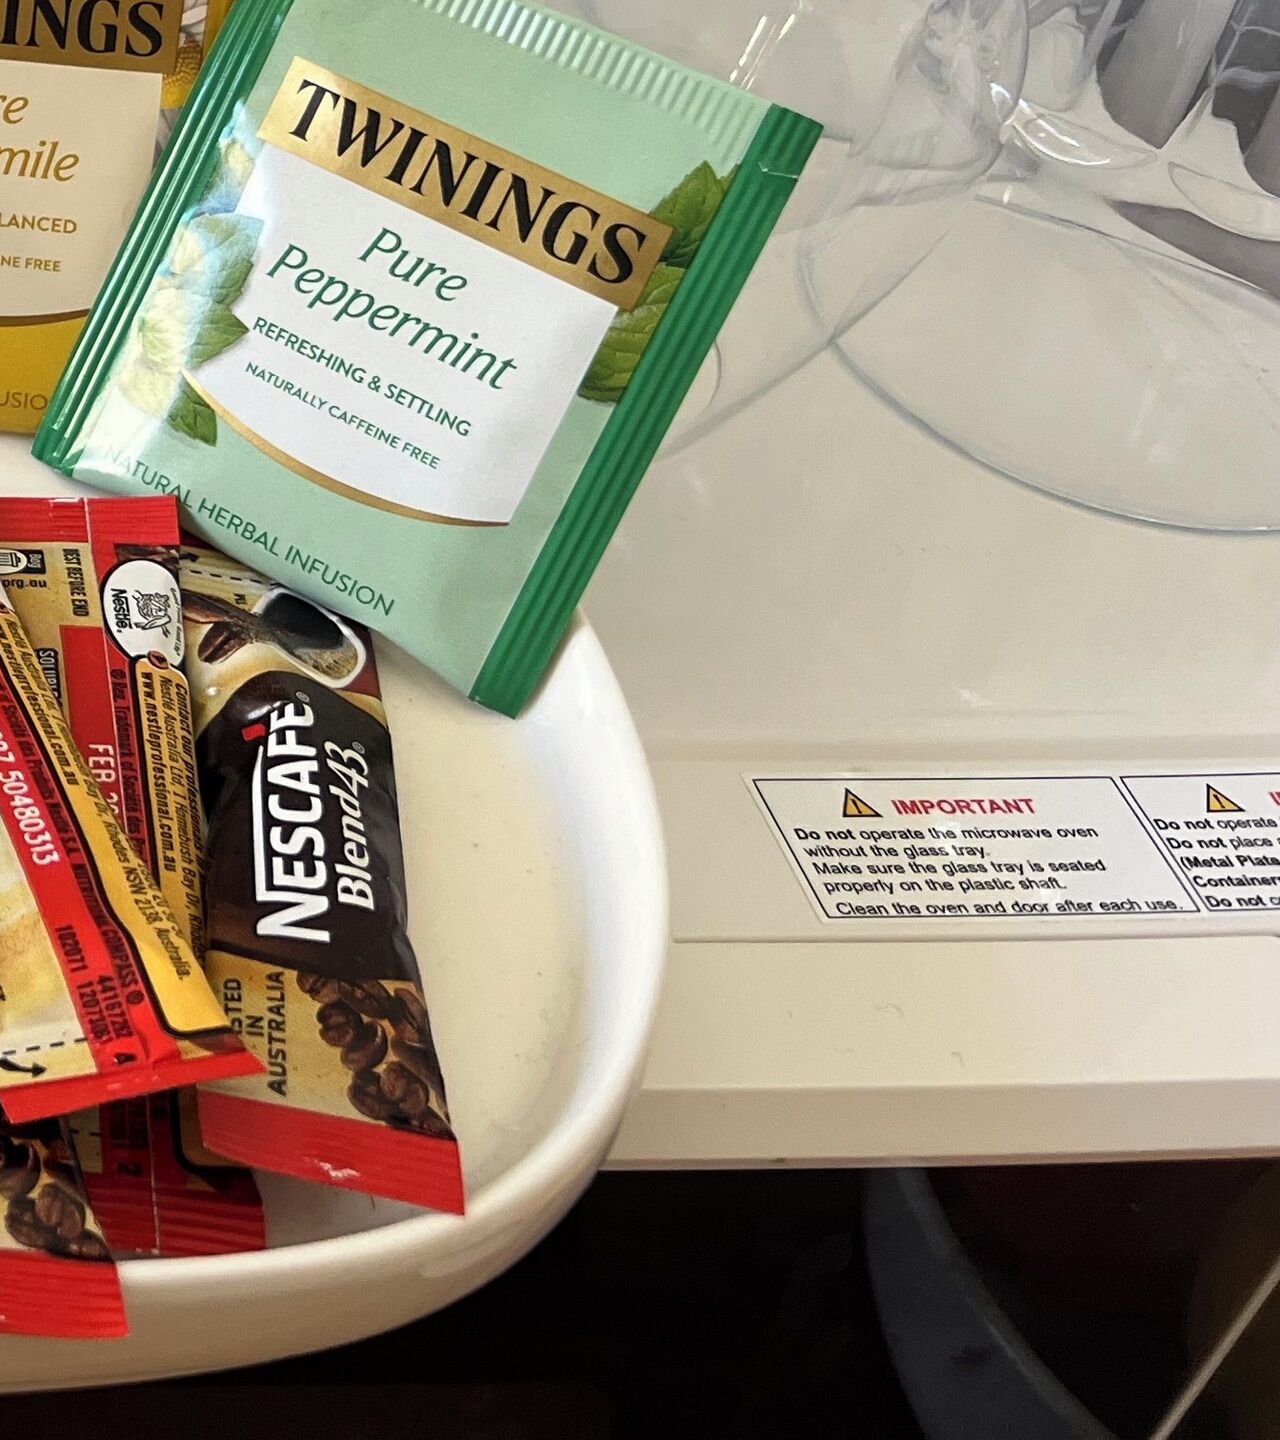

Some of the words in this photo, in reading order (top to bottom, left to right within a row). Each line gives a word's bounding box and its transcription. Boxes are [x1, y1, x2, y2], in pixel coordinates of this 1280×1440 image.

[288, 79, 649, 287] TWININGS
[25, 257, 61, 272] FREE
[356, 227, 468, 303] Pure
[266, 243, 517, 391] Peppermint
[253, 315, 365, 389] REFRESHING
[367, 374, 380, 392] &
[383, 381, 472, 438] SETTLING
[244, 361, 328, 411] NATURALLY
[328, 405, 400, 451] CAFFEINE
[402, 440, 441, 471] FREE
[104, 446, 193, 509] NATURAL
[198, 498, 279, 556] HERBAL
[285, 545, 395, 616] INFUSION
[891, 798, 1036, 815] IMPORTANT
[794, 828, 820, 840] Do
[826, 829, 855, 840] not
[860, 830, 924, 842] operate
[930, 827, 955, 840] the
[961, 827, 1052, 839] microwave
[1057, 828, 1098, 839] oven
[805, 845, 867, 857] without
[870, 845, 899, 857] the
[904, 845, 949, 859] glass
[952, 845, 990, 859] tray.
[812, 862, 862, 874] Make
[869, 864, 905, 874] sure
[909, 862, 937, 874] the
[942, 861, 988, 876] glass
[991, 861, 1023, 875] tray
[1031, 860, 1044, 872] is
[1048, 859, 1106, 872] seated
[823, 880, 894, 894] properly
[900, 881, 922, 891] on
[925, 879, 954, 891] the
[959, 878, 1015, 893] plastic
[1020, 878, 1066, 890] shaft.
[836, 902, 889, 915] Clean
[892, 902, 921, 914] the
[926, 904, 970, 914] oven
[975, 901, 1003, 913] and
[1011, 900, 1049, 913] door
[1056, 900, 1092, 912] after
[1099, 899, 1139, 911] each
[1145, 900, 1183, 910] use.
[266, 971, 287, 1098] AUSTRALIA
